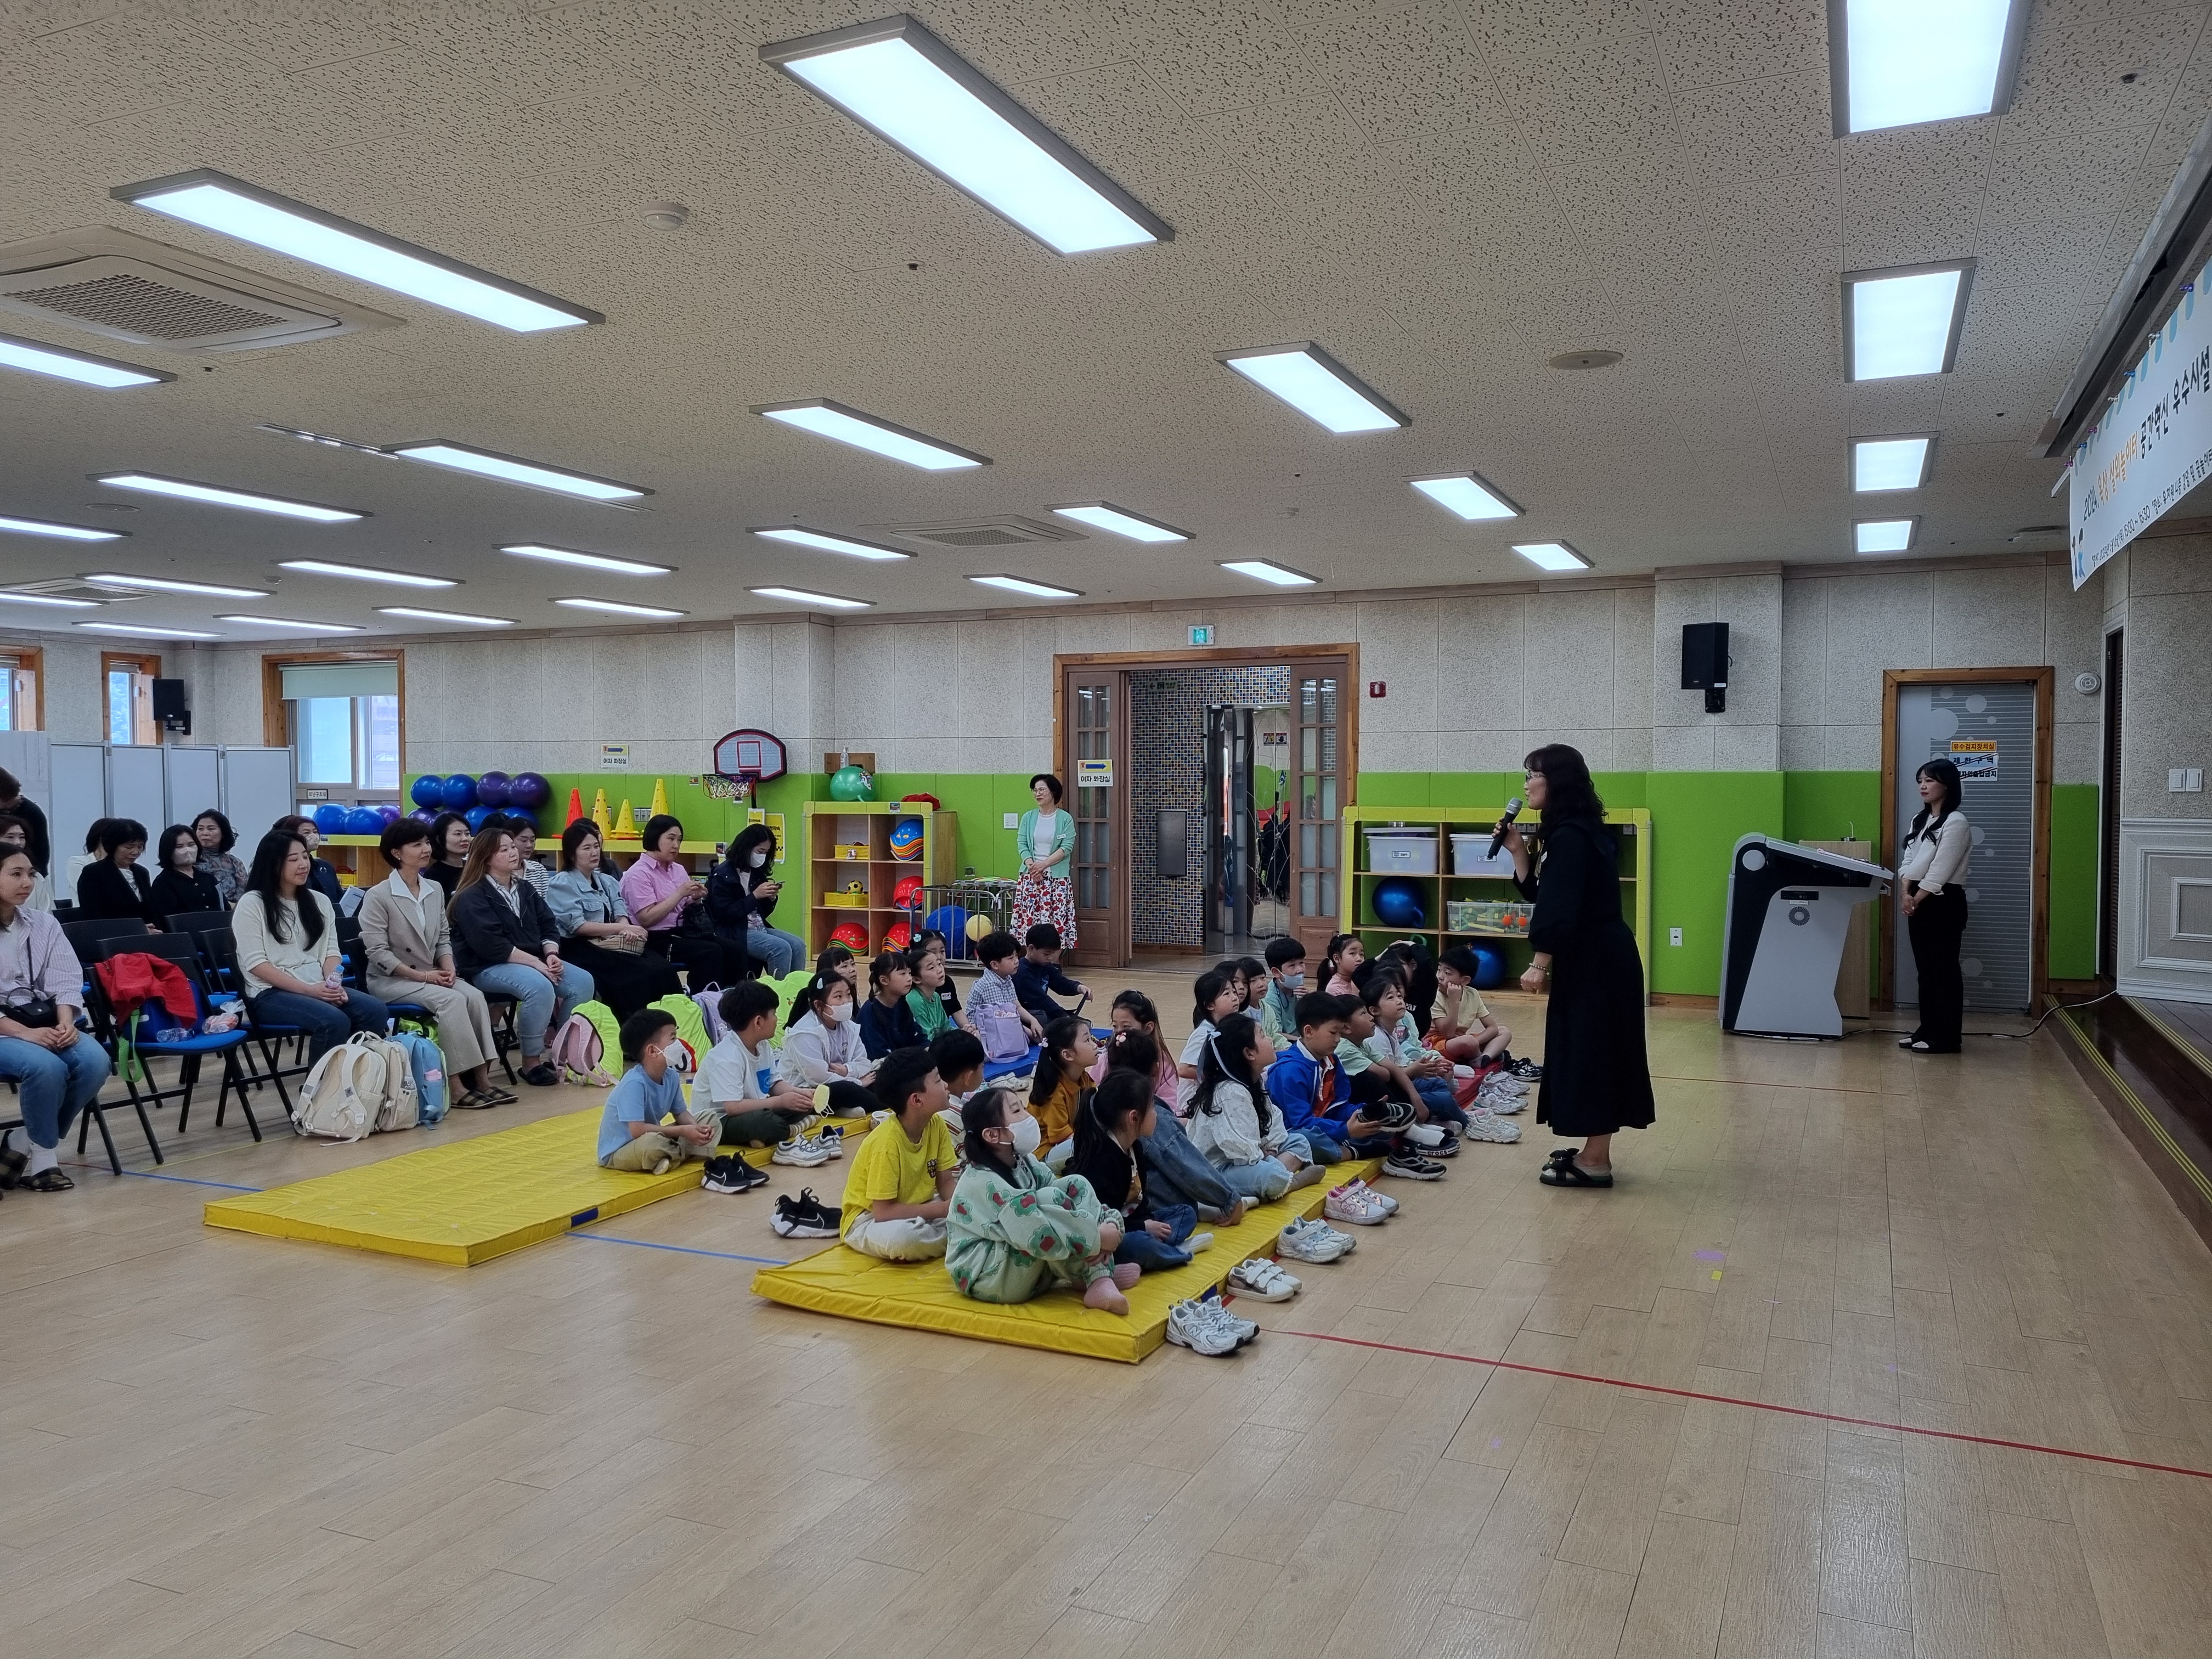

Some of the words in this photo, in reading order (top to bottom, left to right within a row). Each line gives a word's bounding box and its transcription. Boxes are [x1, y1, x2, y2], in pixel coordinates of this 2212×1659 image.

[2098, 468, 2109, 505] 옥상
[2110, 431, 2137, 494] 실외놀이터
[2141, 393, 2168, 460] 공간혁신
[2173, 345, 2210, 415] 우수시설
